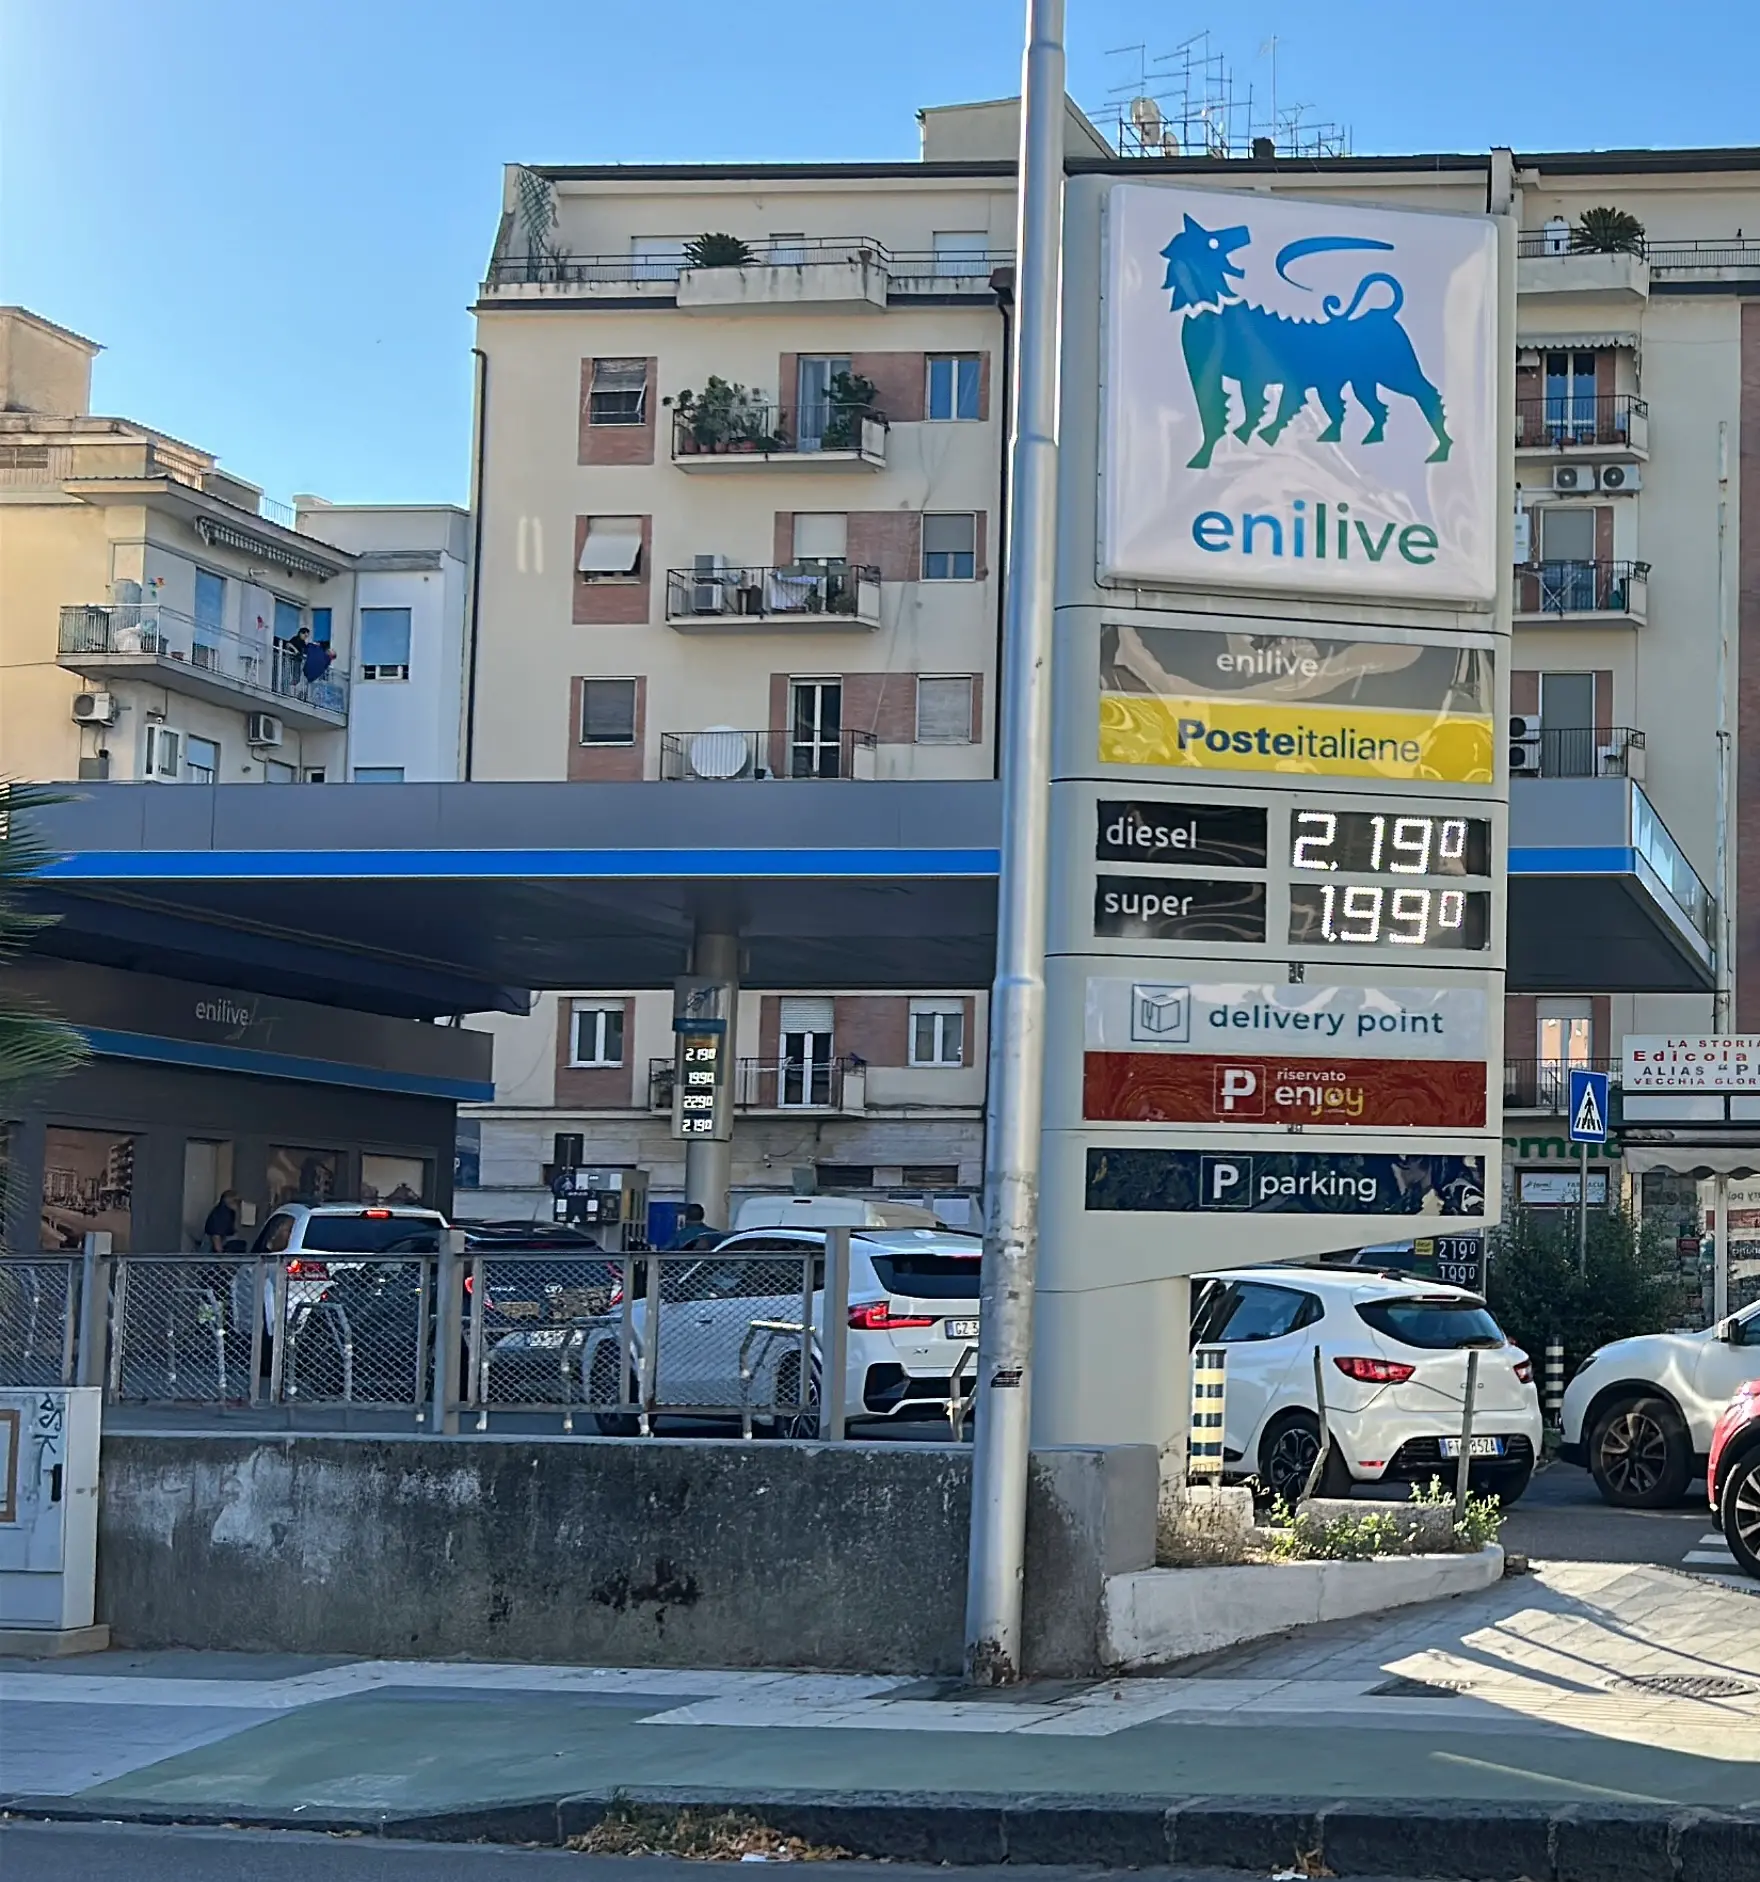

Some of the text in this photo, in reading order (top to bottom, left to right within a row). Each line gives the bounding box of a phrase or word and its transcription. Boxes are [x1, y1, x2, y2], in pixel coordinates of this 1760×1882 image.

[1192, 500, 1439, 565] enilive
[1216, 649, 1319, 678] enilive
[1178, 718, 1420, 762] Posteitaliane
[1106, 819, 1197, 850] diesel
[1104, 891, 1193, 921] super
[195, 998, 249, 1026] enilive
[1209, 1004, 1444, 1037] delivery point
[1633, 1051, 1747, 1062] Edicola
[1667, 1040, 1688, 1048] LA
[1634, 1077, 1705, 1086] VECCHIA
[1642, 1066, 1704, 1076] ALIAS
[1221, 1068, 1346, 1110] P riservato
[1275, 1086, 1364, 1116] enjoy
[1213, 1164, 1377, 1200] P parking
